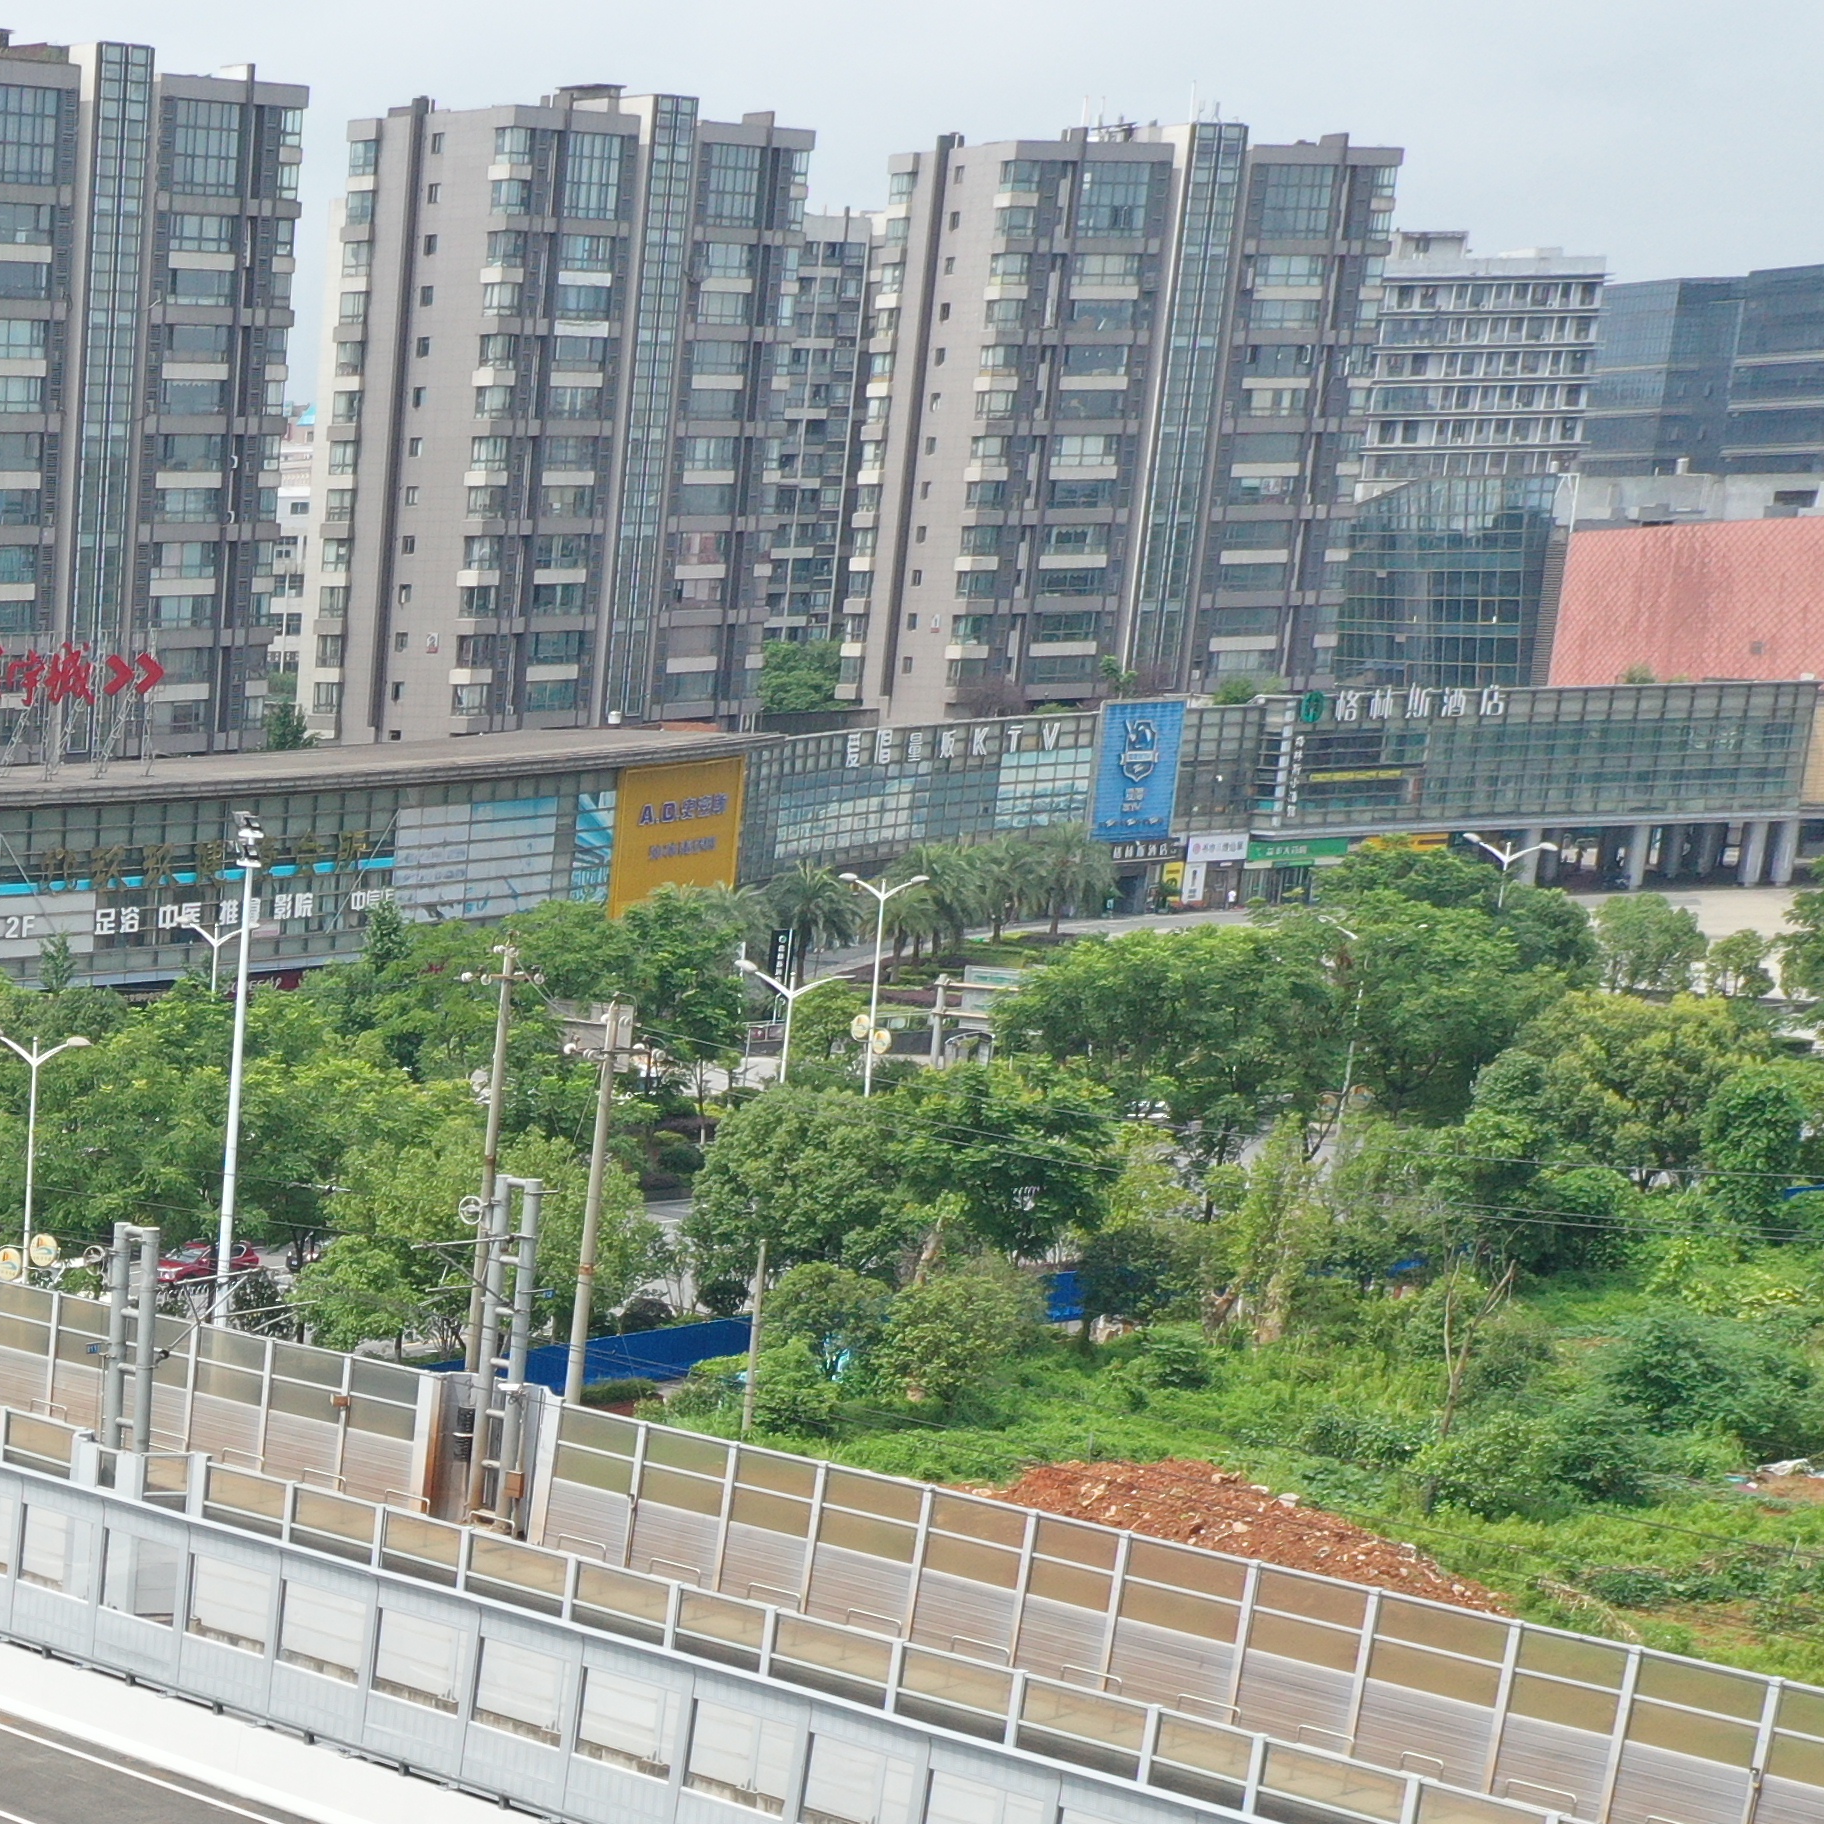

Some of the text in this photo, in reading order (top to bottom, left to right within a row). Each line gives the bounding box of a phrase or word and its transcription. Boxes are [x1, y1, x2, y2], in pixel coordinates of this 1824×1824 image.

[5, 915, 35, 939] 2F
[95, 906, 140, 935] 足浴
[274, 892, 314, 919] 影院
